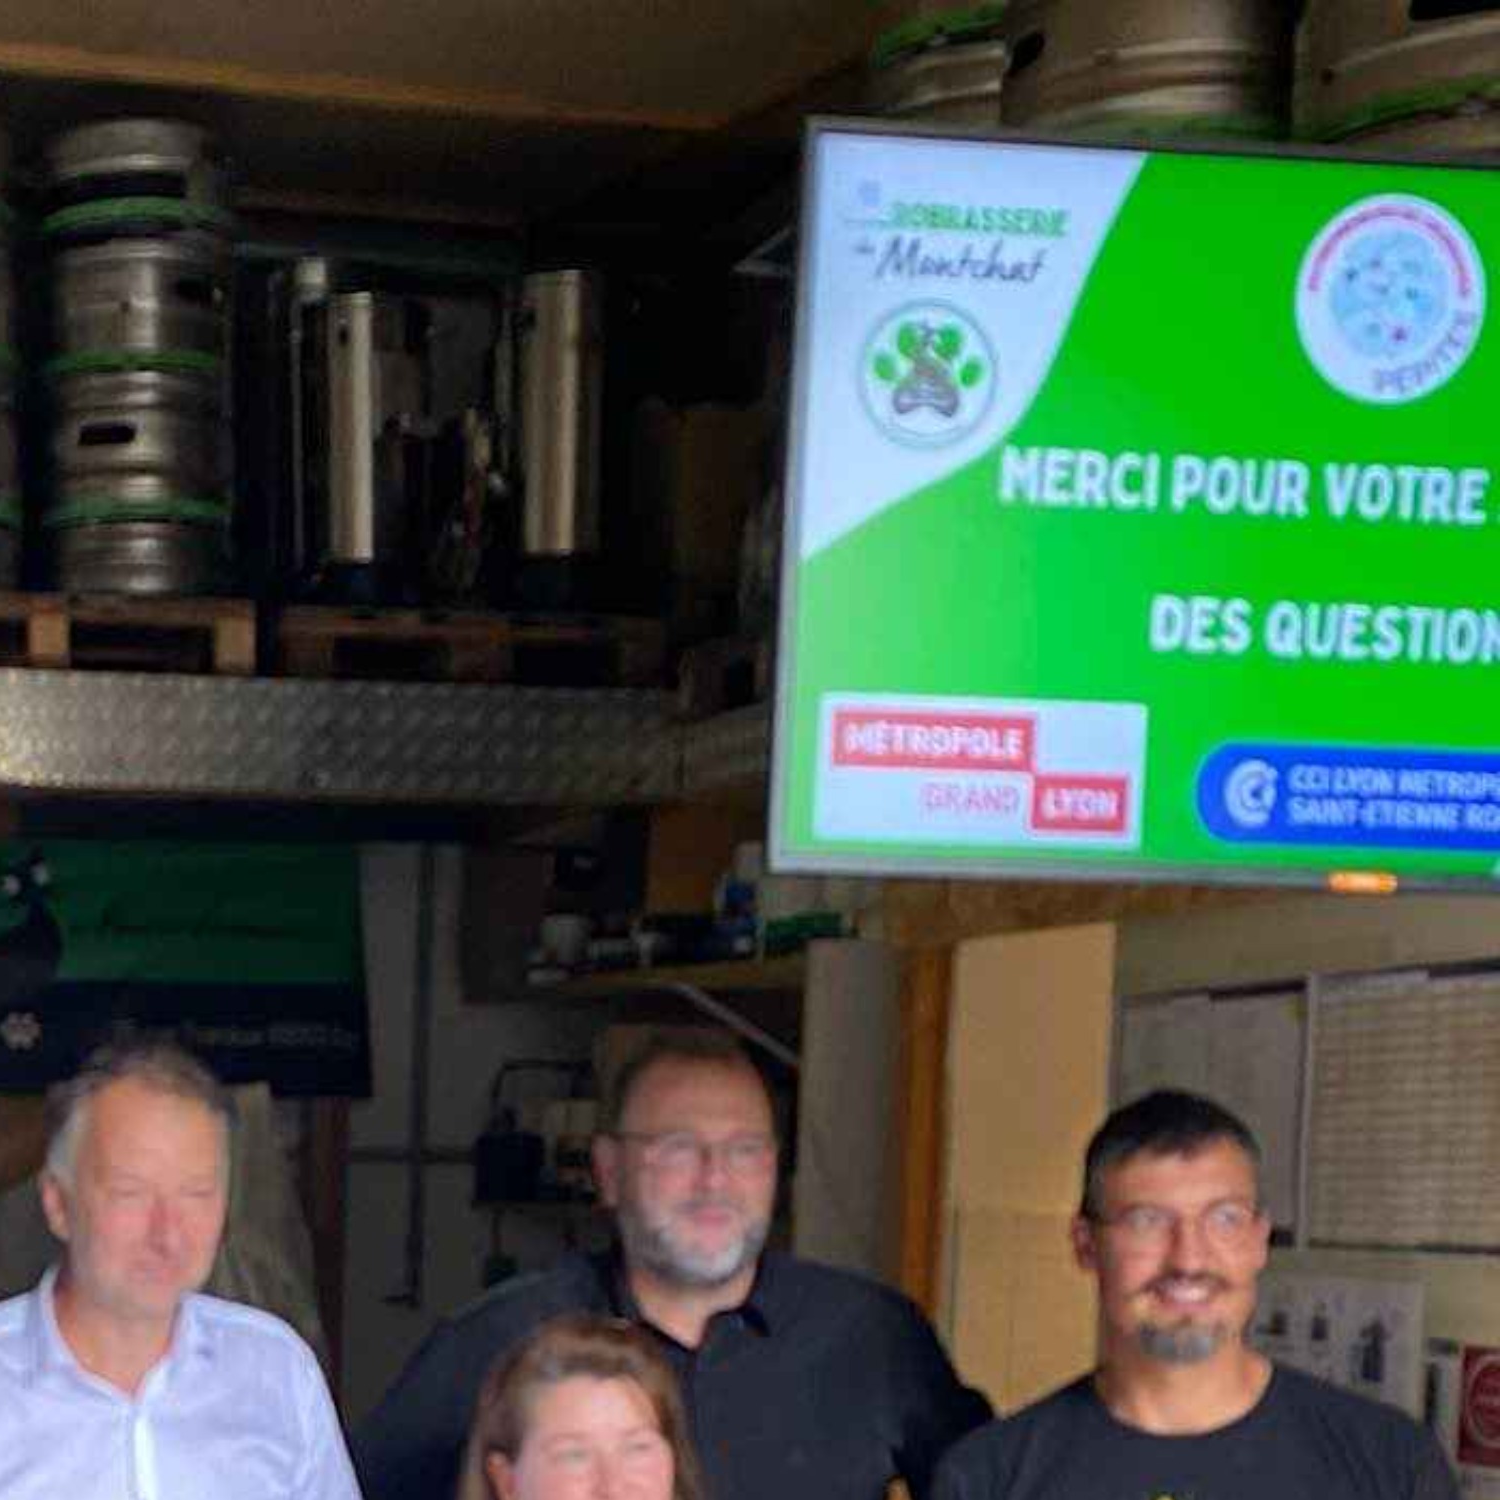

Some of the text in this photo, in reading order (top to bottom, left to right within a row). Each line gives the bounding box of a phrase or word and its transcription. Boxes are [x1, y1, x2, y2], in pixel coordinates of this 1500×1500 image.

[1000, 445, 1489, 526] MERCI POUR VOTRE
[1149, 594, 1252, 655] DES
[845, 718, 1025, 761] MÉTROPOLE
[1041, 786, 1120, 823] LYON
